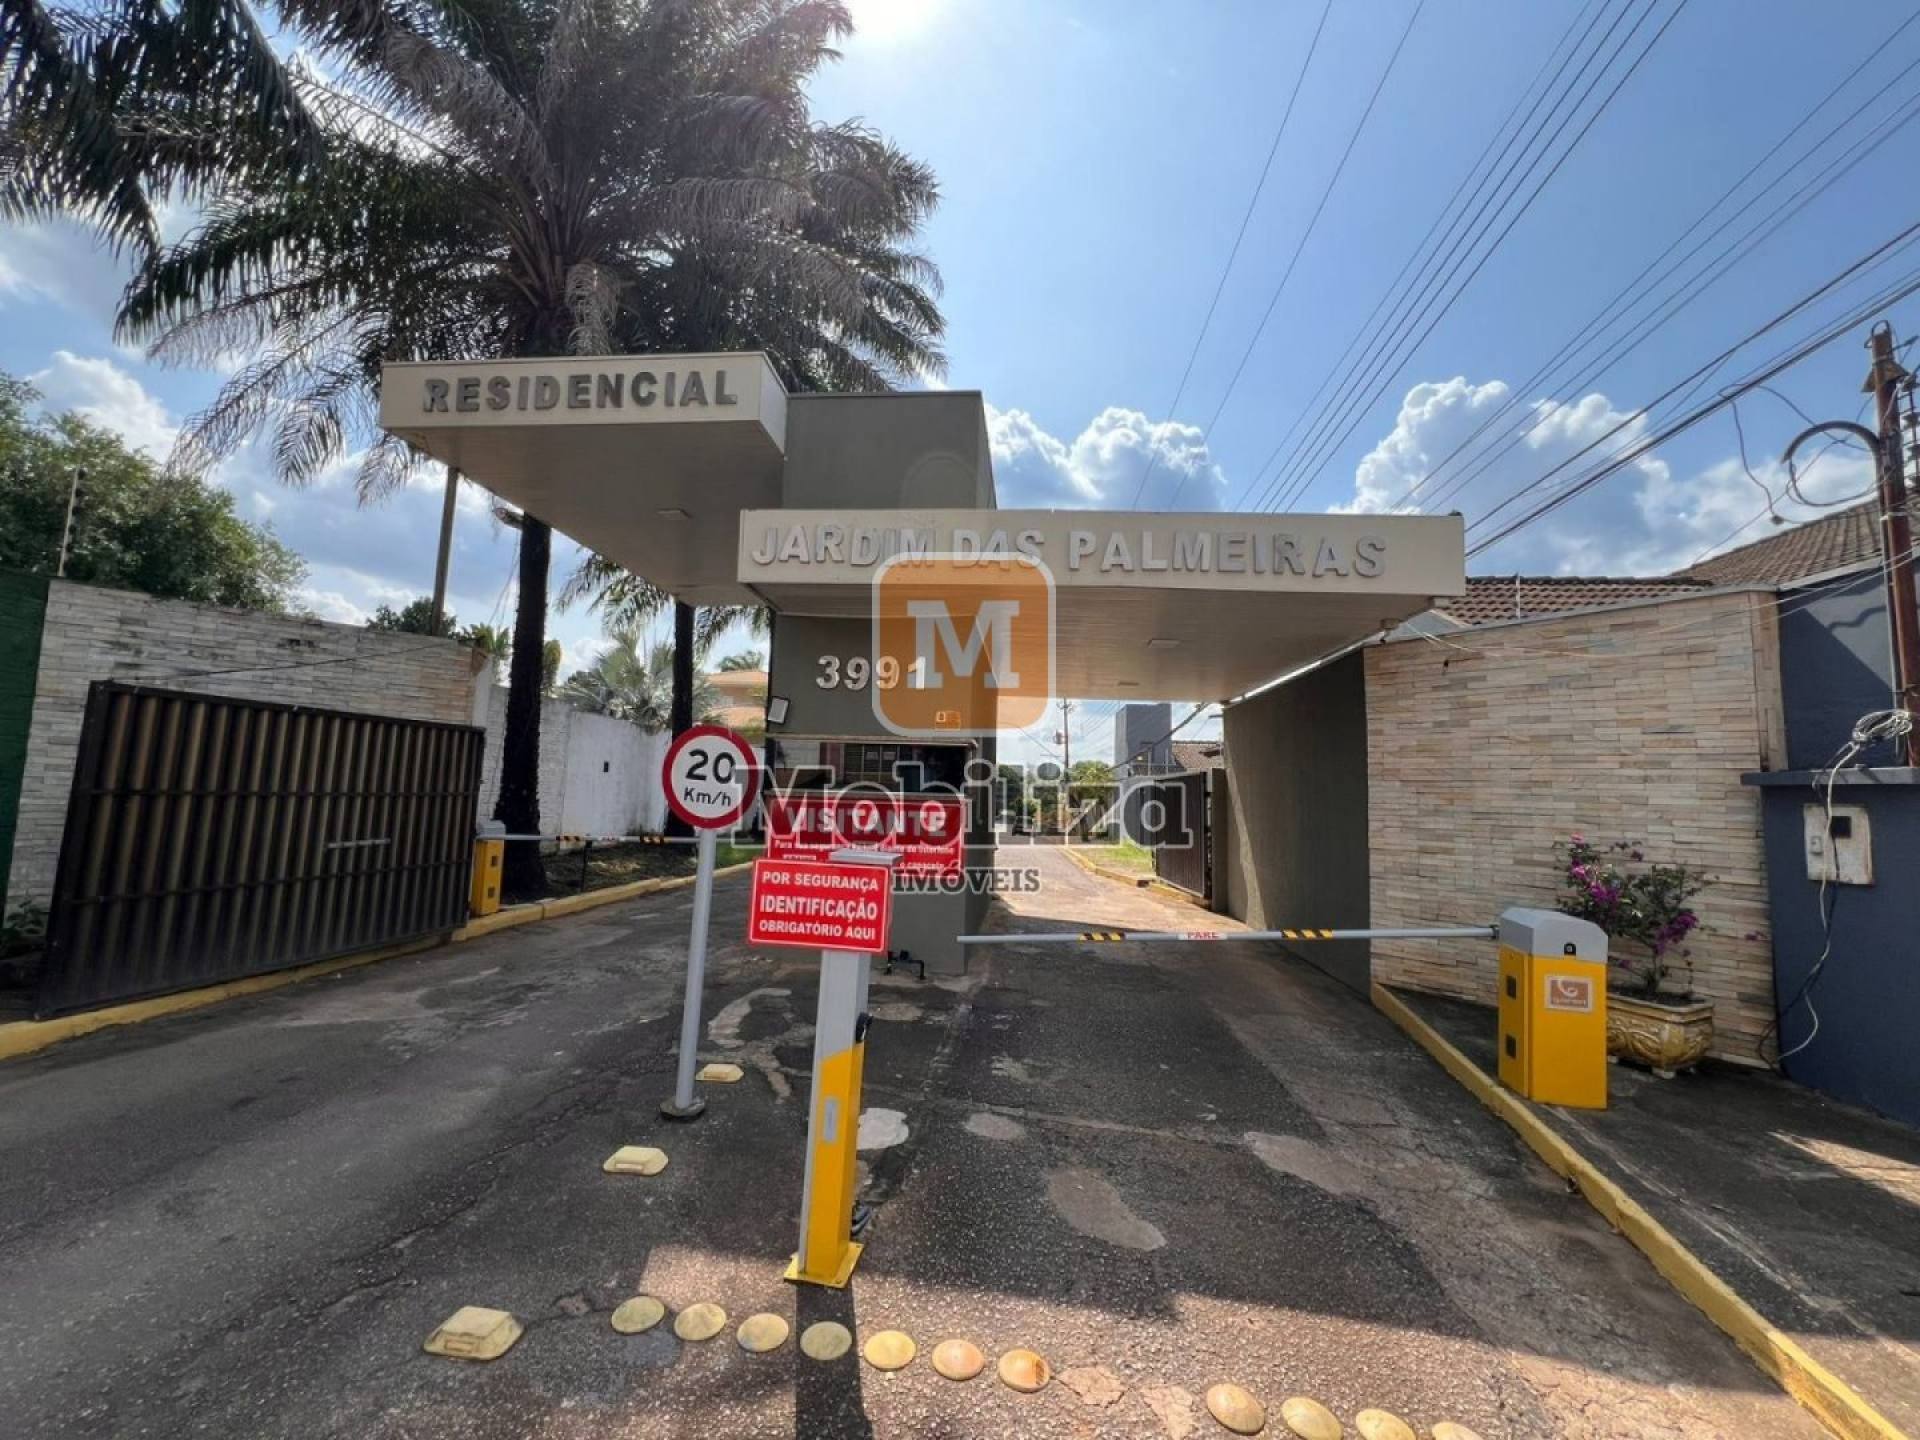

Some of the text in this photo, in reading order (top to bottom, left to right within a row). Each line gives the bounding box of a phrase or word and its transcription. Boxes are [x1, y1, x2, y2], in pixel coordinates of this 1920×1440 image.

[422, 370, 738, 413] RESIDENCIAL
[751, 524, 1386, 578] JARDIM DAS PALMEIRAS
[815, 655, 927, 690] 3991
[685, 748, 737, 785] 20
[683, 786, 733, 807] Km/h
[787, 806, 948, 837] VISITANTE
[762, 871, 879, 893] POR SEGURANÇA
[760, 895, 878, 922] IDENTIFICAÇÃO
[759, 919, 876, 940] OBRIGATÓRIO AQUI
